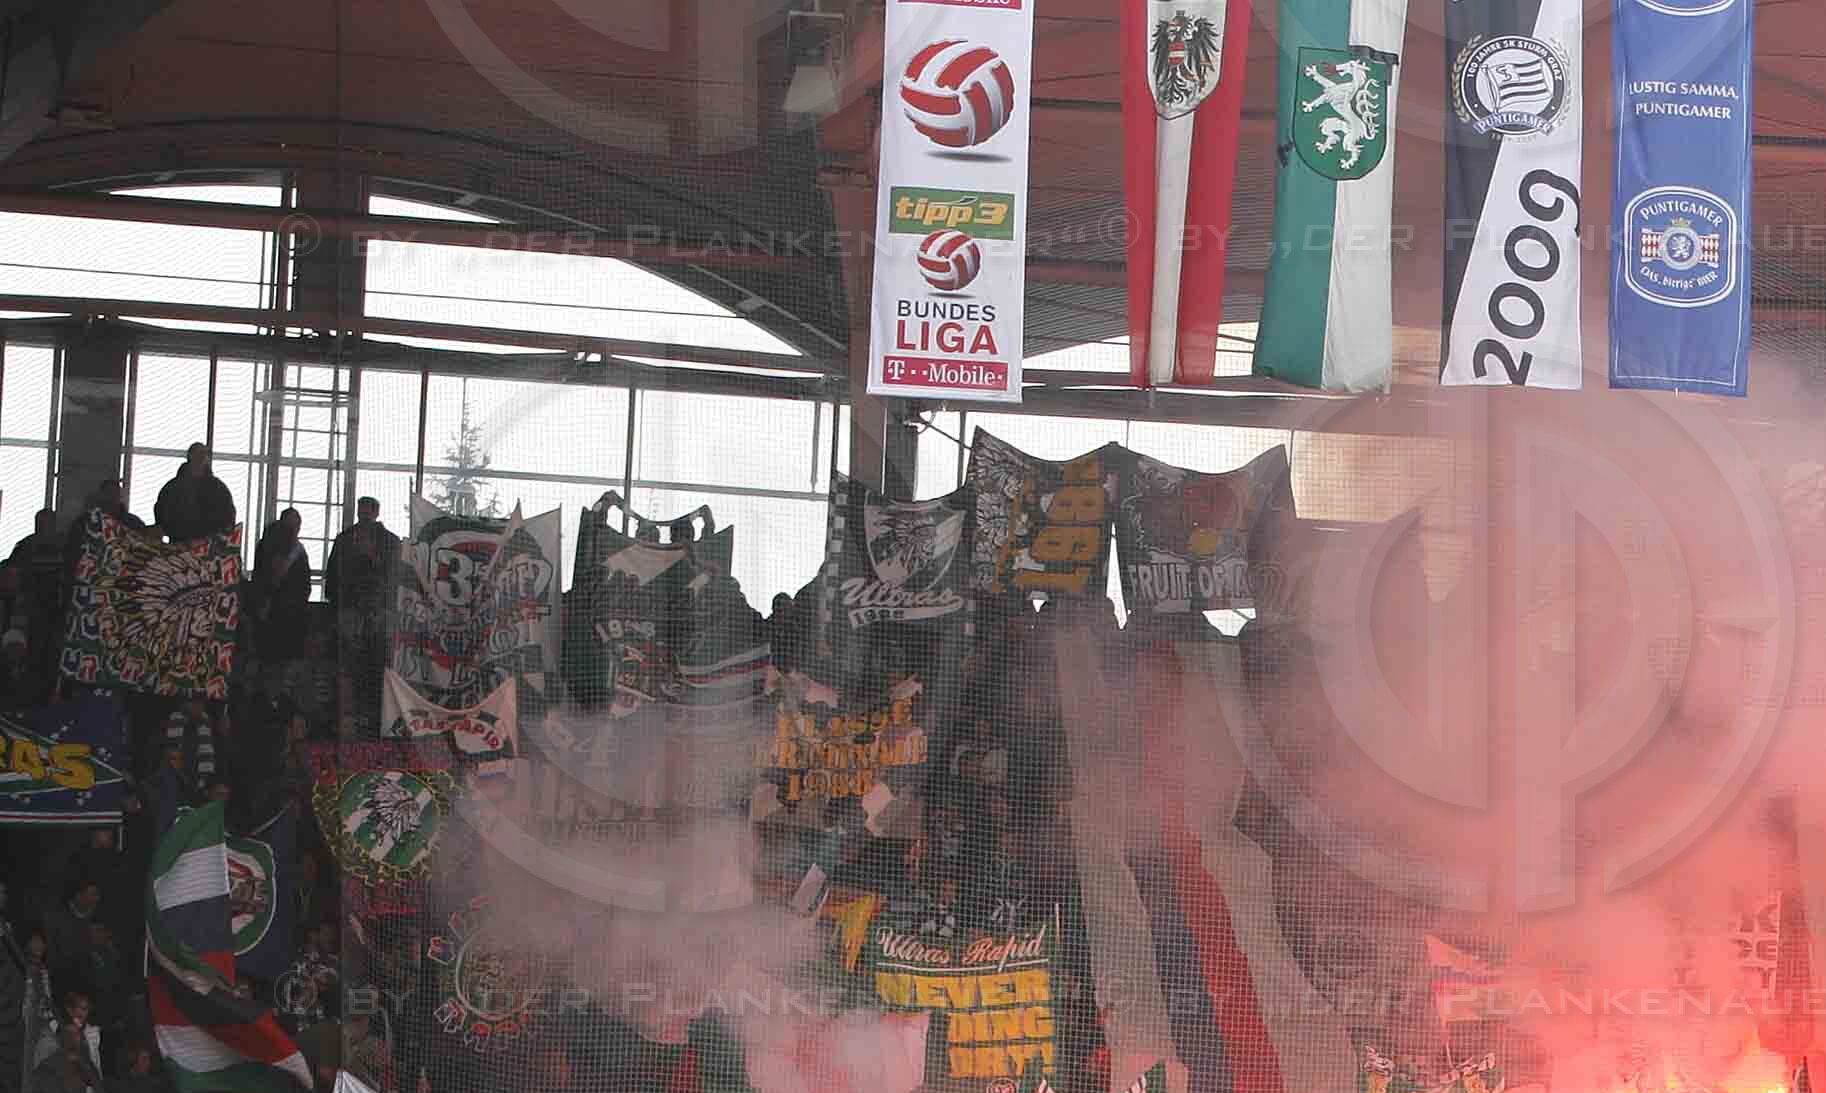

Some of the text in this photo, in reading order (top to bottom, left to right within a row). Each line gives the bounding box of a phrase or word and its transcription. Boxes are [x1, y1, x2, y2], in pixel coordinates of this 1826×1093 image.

[1476, 111, 1551, 134] PUNTIGAMER
[1635, 103, 1732, 119] PUNTIGAMER
[1640, 199, 1724, 227] PUNTIGAMER
[1472, 168, 1581, 386] 2009
[896, 300, 997, 321] BUNDES
[895, 319, 999, 354] LIGA
[840, 576, 964, 609] Ultras
[962, 925, 1047, 972] Rapid
[875, 968, 1054, 1009] NEVER
